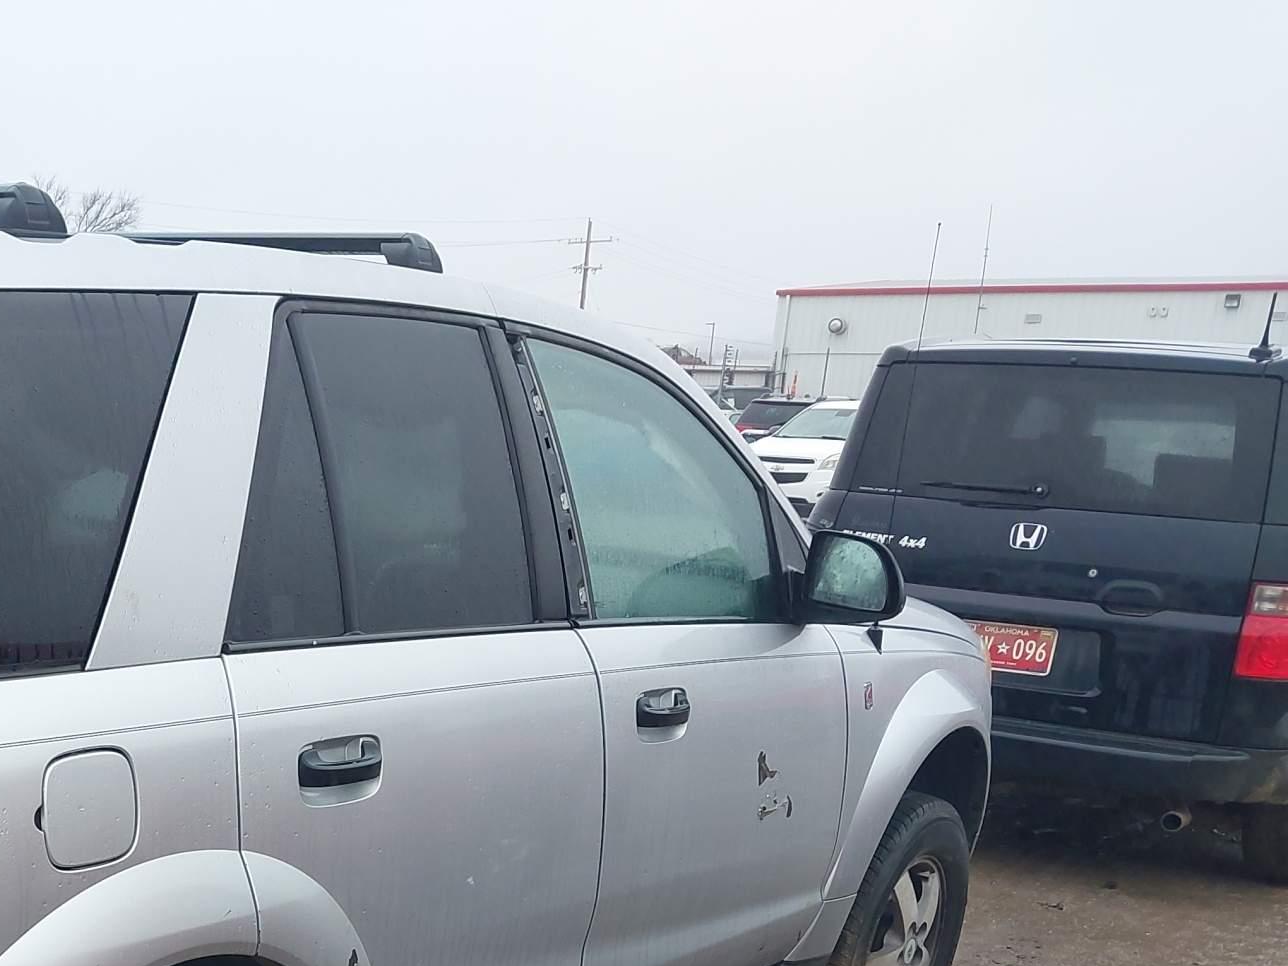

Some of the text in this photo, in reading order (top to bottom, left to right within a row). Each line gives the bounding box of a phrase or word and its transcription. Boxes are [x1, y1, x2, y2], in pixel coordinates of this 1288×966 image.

[898, 535, 927, 549] 4x4
[984, 625, 1030, 637] OKLAHOMA
[1012, 638, 1047, 662] 096
